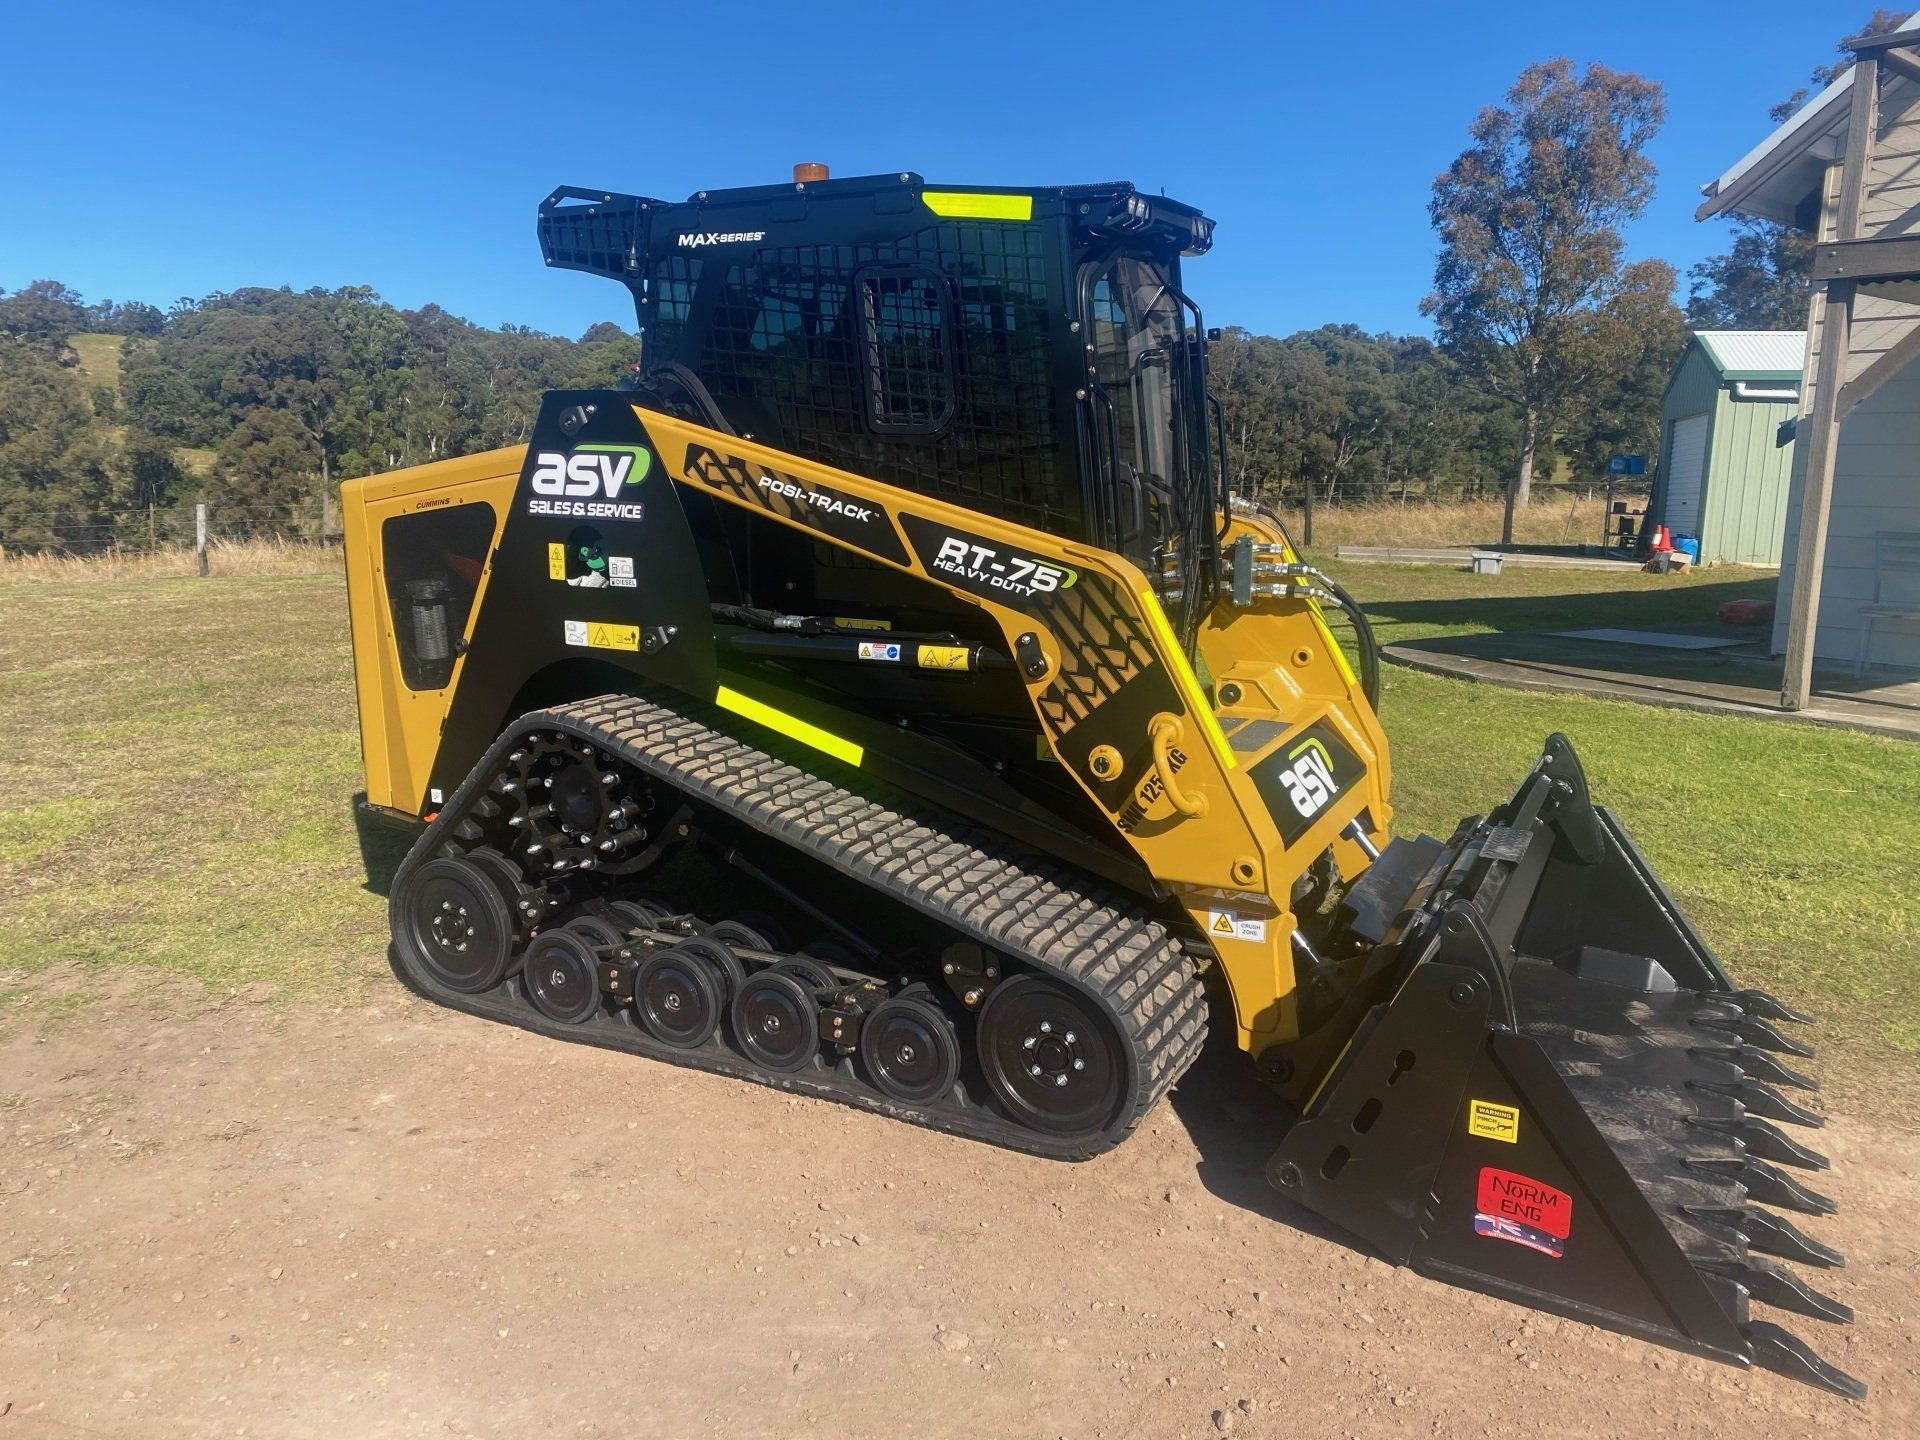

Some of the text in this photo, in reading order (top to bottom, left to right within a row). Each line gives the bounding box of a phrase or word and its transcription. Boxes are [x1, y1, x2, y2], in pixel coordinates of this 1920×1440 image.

[416, 498, 450, 509] CUMMINS
[572, 502, 586, 516] &
[587, 503, 641, 519] SERVICE
[758, 476, 872, 522] POSI-TRACK
[937, 537, 1062, 592] RT-75
[933, 557, 1037, 597] HEAVY DUTY
[1117, 801, 1148, 834] SWL
[1477, 1115, 1498, 1124] PINCH
[1479, 1107, 1512, 1119] WARNING
[1477, 1123, 1497, 1132] POINT
[1492, 1176, 1557, 1208] NORM
[1501, 1199, 1542, 1222] ENG
